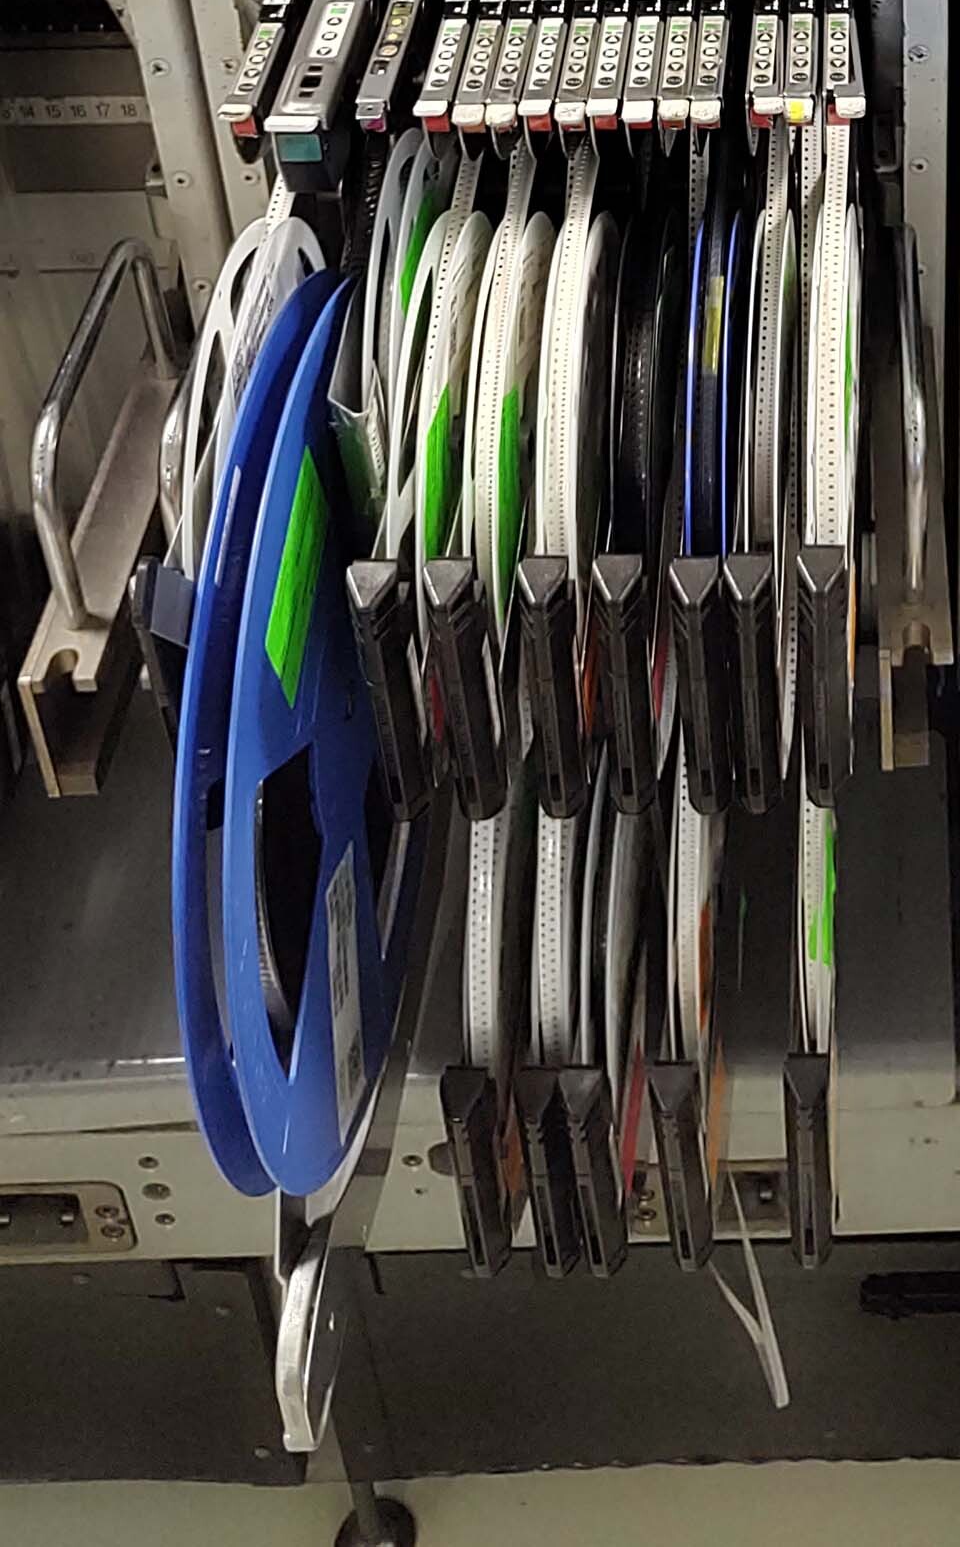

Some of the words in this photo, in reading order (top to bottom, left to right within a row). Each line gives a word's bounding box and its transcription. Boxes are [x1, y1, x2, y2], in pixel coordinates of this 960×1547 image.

[45, 105, 61, 118] 15
[70, 105, 87, 118] 16
[95, 104, 110, 117] 17
[120, 104, 137, 117] 18
